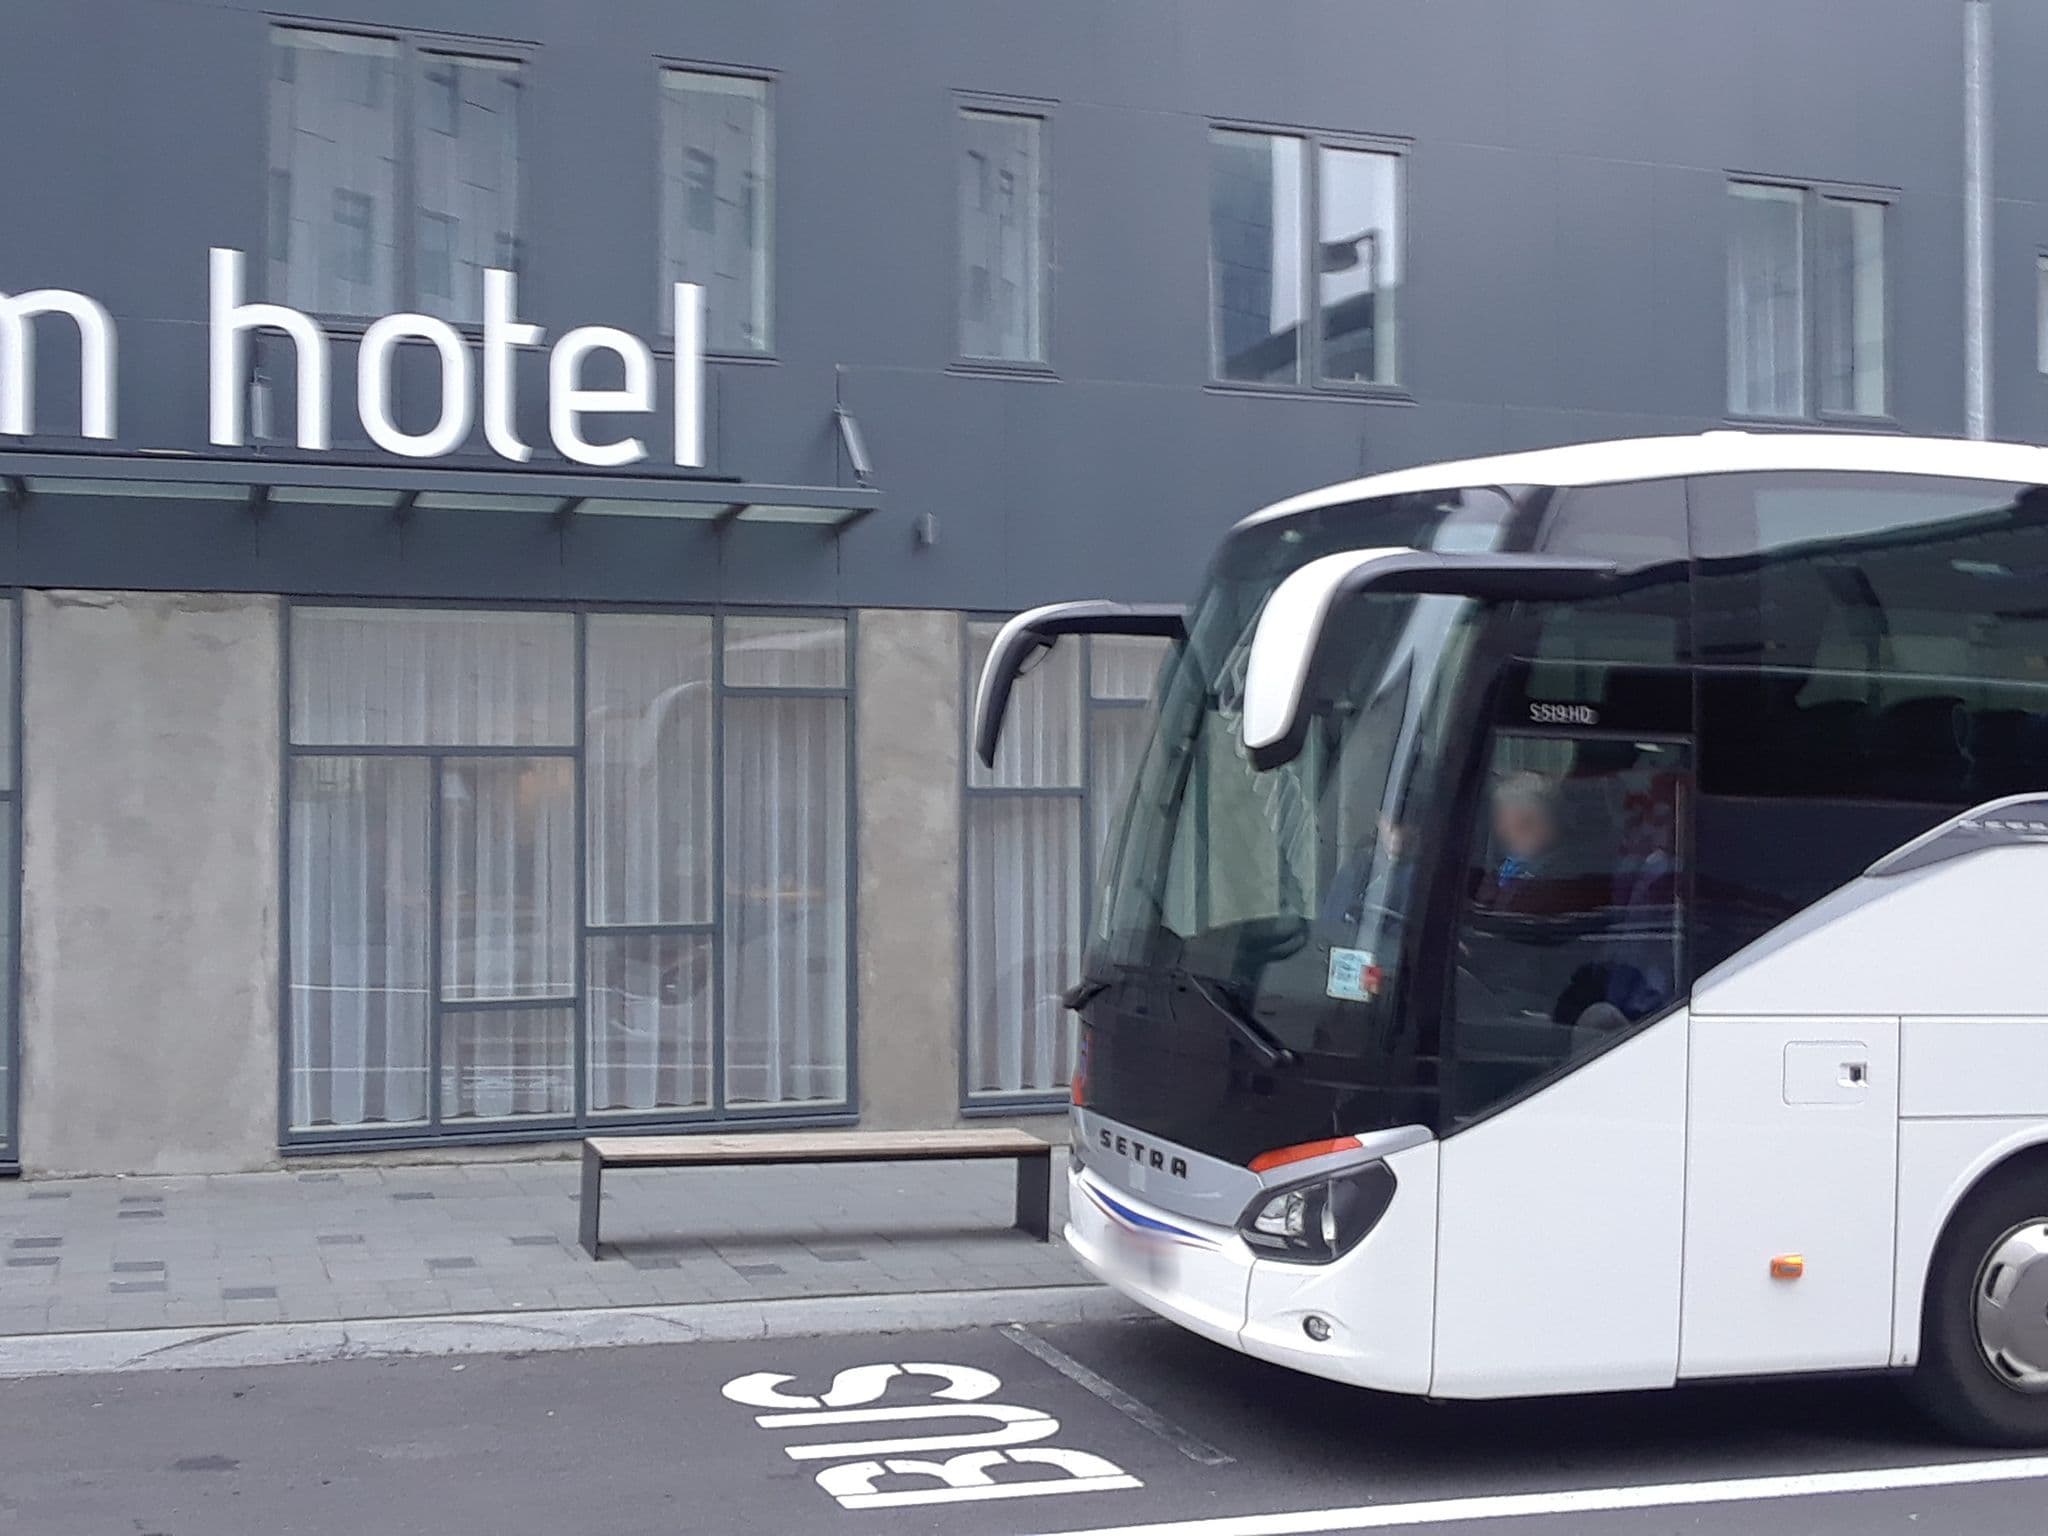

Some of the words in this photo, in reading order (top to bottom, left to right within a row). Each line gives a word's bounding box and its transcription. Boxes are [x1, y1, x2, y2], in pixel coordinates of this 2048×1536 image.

[208, 247, 706, 468] hotel
[1099, 1127, 1188, 1180] SETRA
[721, 1362, 1145, 1509] BUS
